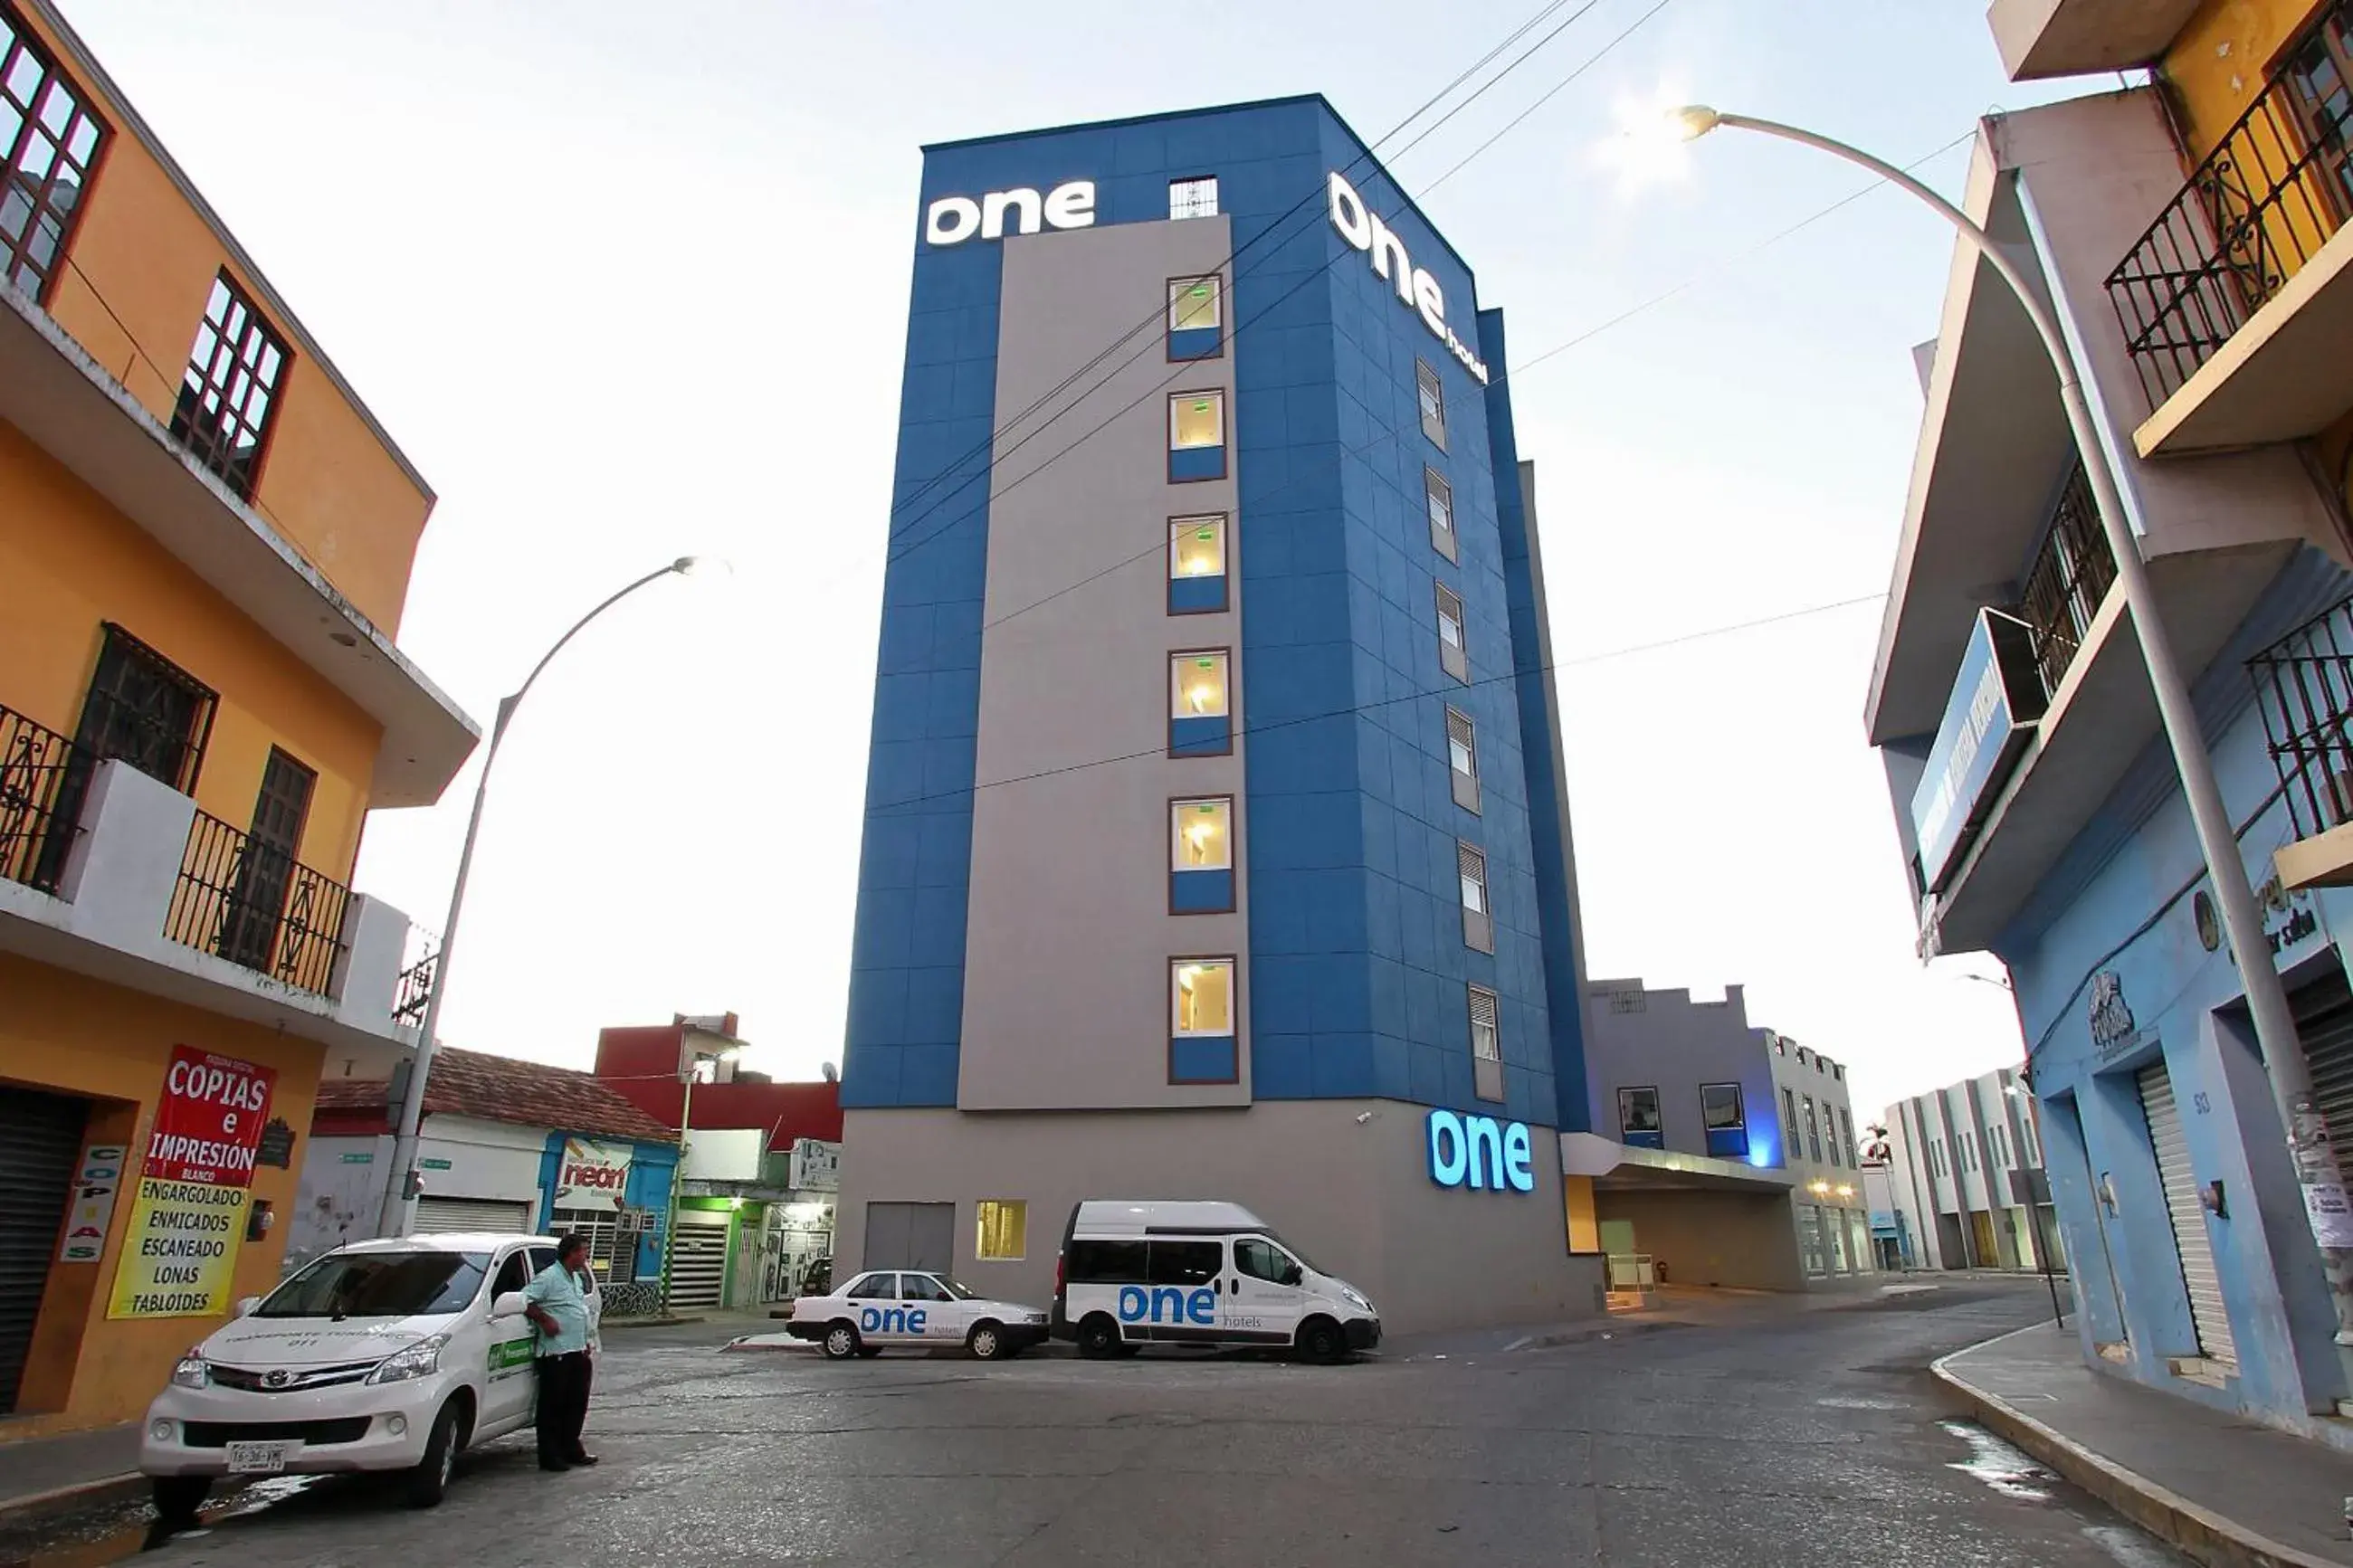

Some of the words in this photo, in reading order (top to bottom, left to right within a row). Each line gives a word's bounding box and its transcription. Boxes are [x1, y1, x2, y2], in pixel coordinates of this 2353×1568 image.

[926, 180, 1096, 245] one
[1328, 171, 1446, 341] one
[1446, 326, 1489, 386] hotel
[168, 1060, 267, 1111] COPIAS
[223, 1112, 238, 1134] e
[148, 1132, 257, 1171] IMPRESIÓN
[1425, 1109, 1535, 1193] one
[148, 1210, 231, 1231] ENMICADOS
[141, 1238, 224, 1257] ESCANEADO
[153, 1266, 198, 1284] LONAS
[131, 1293, 210, 1313] TABLOIDES
[1119, 1286, 1215, 1325] one
[1224, 1316, 1262, 1328] hotels
[861, 1307, 927, 1334] one
